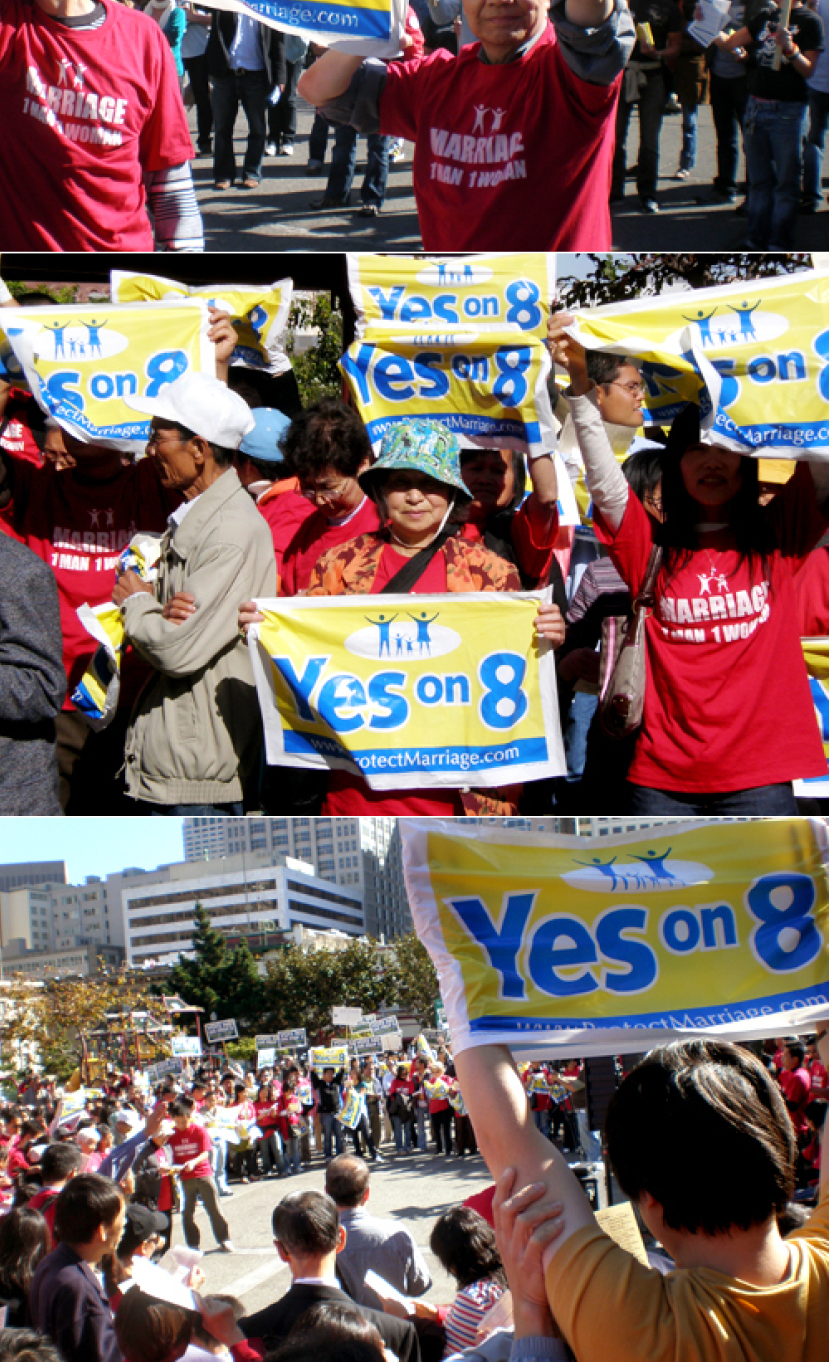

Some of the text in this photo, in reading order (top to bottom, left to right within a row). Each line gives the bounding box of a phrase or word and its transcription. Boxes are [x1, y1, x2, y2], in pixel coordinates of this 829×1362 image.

[430, 162, 438, 179] 1
[469, 170, 478, 188] 1
[367, 279, 543, 332] Yes on 8
[90, 371, 138, 401] on
[145, 348, 192, 399] 8
[341, 342, 533, 408] Yes on 8
[745, 348, 810, 386] on
[51, 552, 59, 567] 1
[59, 553, 90, 571] MAN
[95, 557, 103, 572] 1
[711, 626, 721, 643] 1
[271, 650, 529, 735] Yes on 8
[442, 871, 823, 1003] Yes on 8
